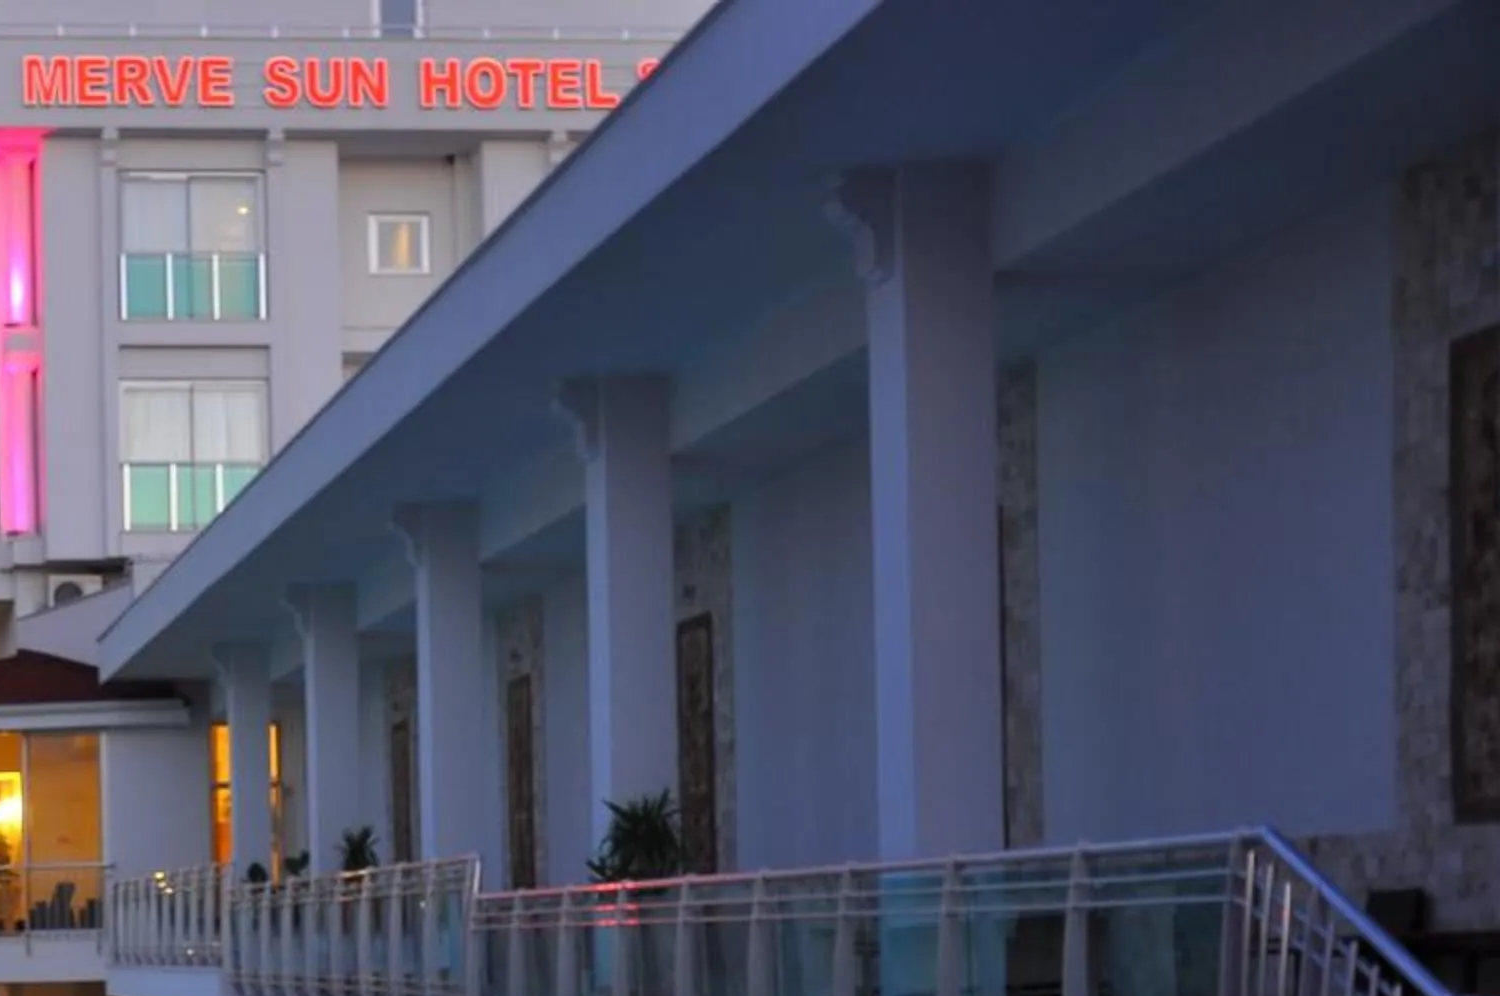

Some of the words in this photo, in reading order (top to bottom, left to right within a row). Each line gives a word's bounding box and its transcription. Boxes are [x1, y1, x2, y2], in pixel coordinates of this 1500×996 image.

[23, 55, 234, 106] MERVE
[264, 56, 390, 108] SUN
[419, 58, 619, 109] HOTEL
